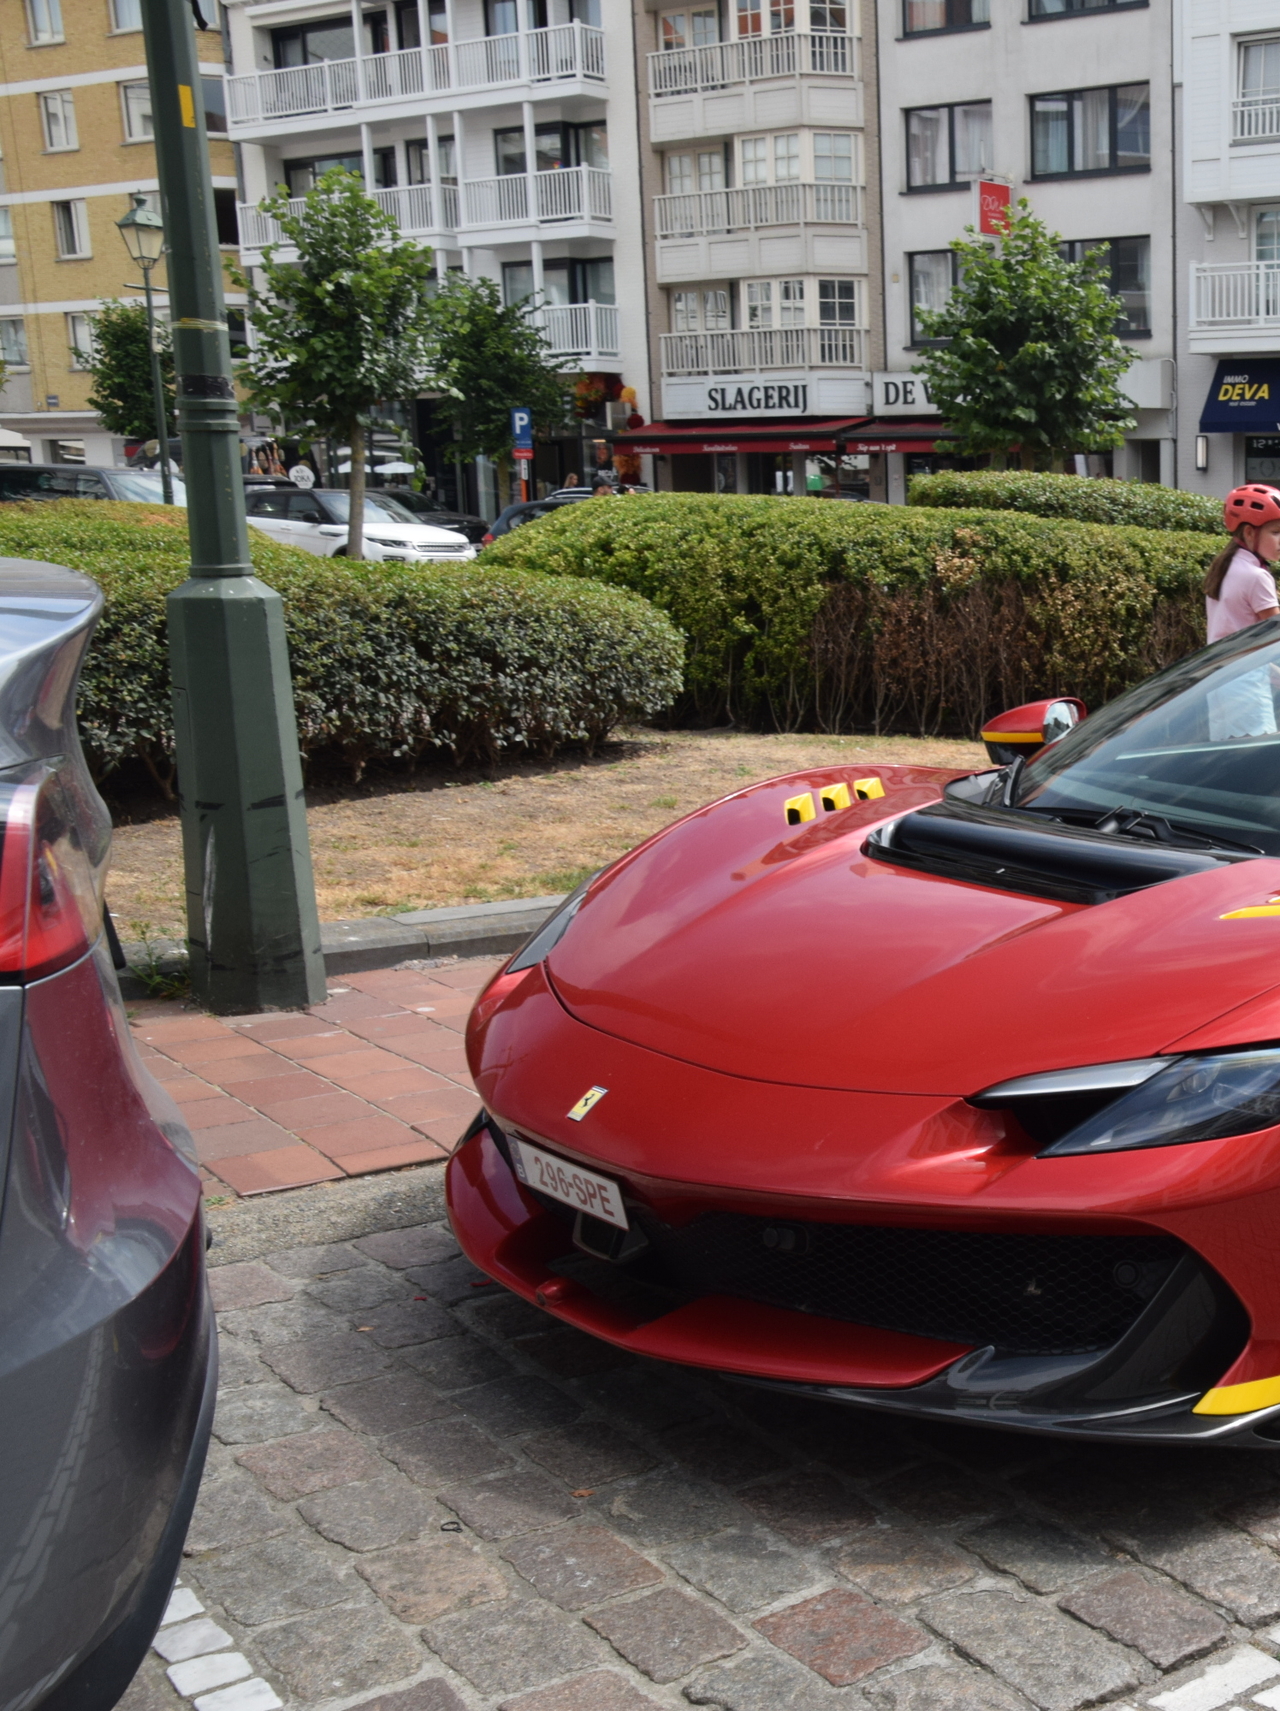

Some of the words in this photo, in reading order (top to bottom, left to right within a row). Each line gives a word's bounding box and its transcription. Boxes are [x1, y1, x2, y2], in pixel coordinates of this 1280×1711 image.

[1223, 374, 1248, 384] IMMO
[708, 384, 808, 414] SLAGERIJ
[884, 380, 916, 406] DE
[1218, 384, 1270, 400] DEVA
[514, 412, 528, 434] P
[516, 1165, 525, 1178] B
[534, 1156, 616, 1218] 296-SPE
